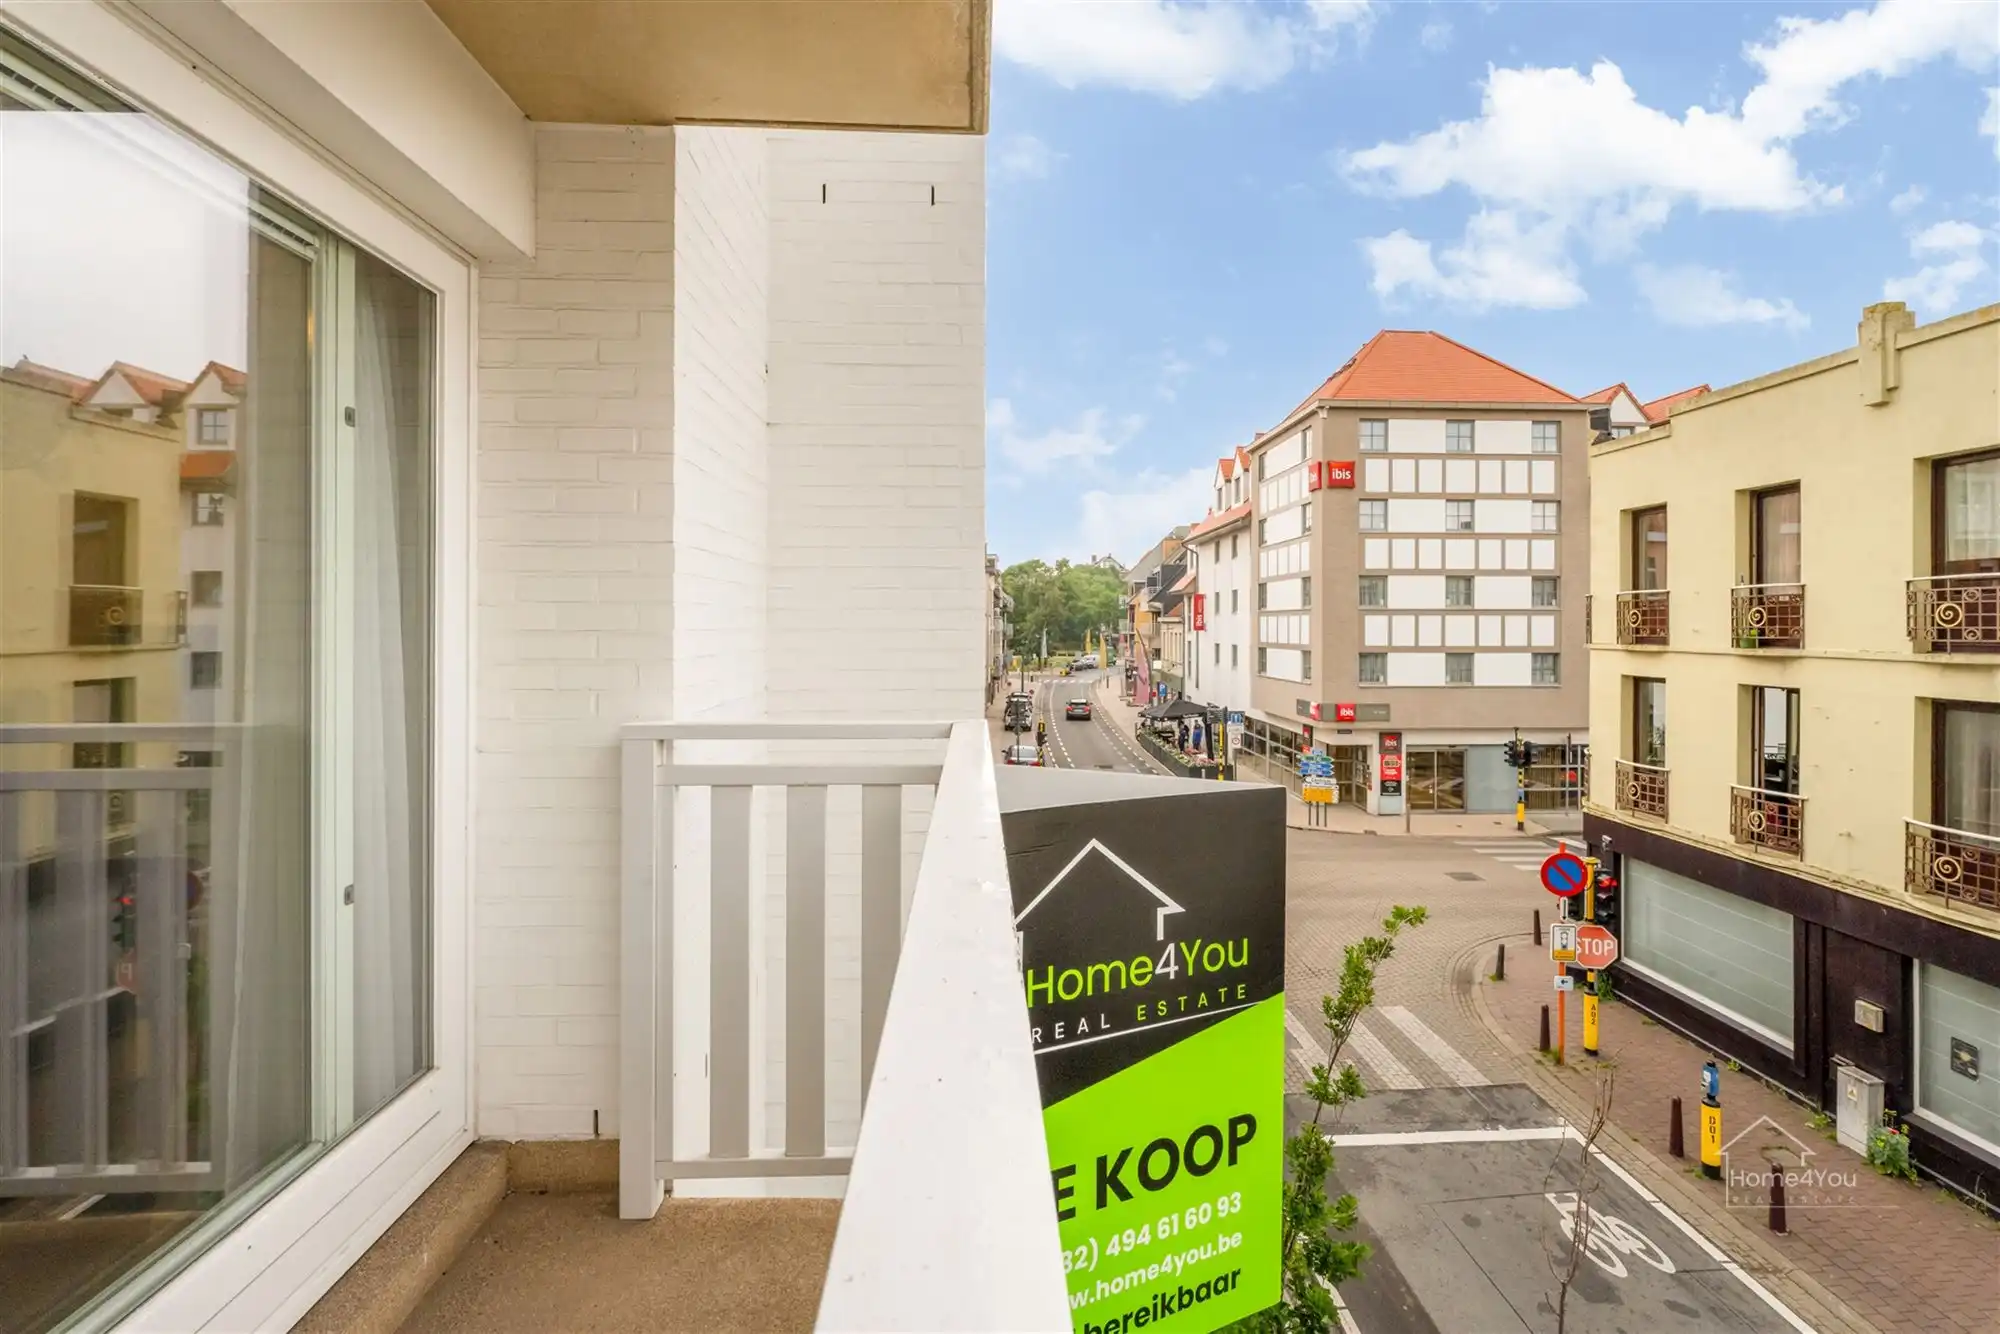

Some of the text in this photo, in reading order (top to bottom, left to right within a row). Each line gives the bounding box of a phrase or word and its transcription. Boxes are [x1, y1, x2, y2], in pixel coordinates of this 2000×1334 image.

[1332, 467, 1352, 480] ibis
[1339, 708, 1355, 717] ibis
[1027, 938, 1249, 1008] Home4You
[1031, 984, 1247, 1044] REAL ESTATE
[1096, 1113, 1257, 1210] KOOP
[1106, 1224, 1152, 1257] 494
[1157, 1213, 1180, 1240] 61
[1184, 1203, 1212, 1230] 60
[1217, 1192, 1242, 1218] 93
